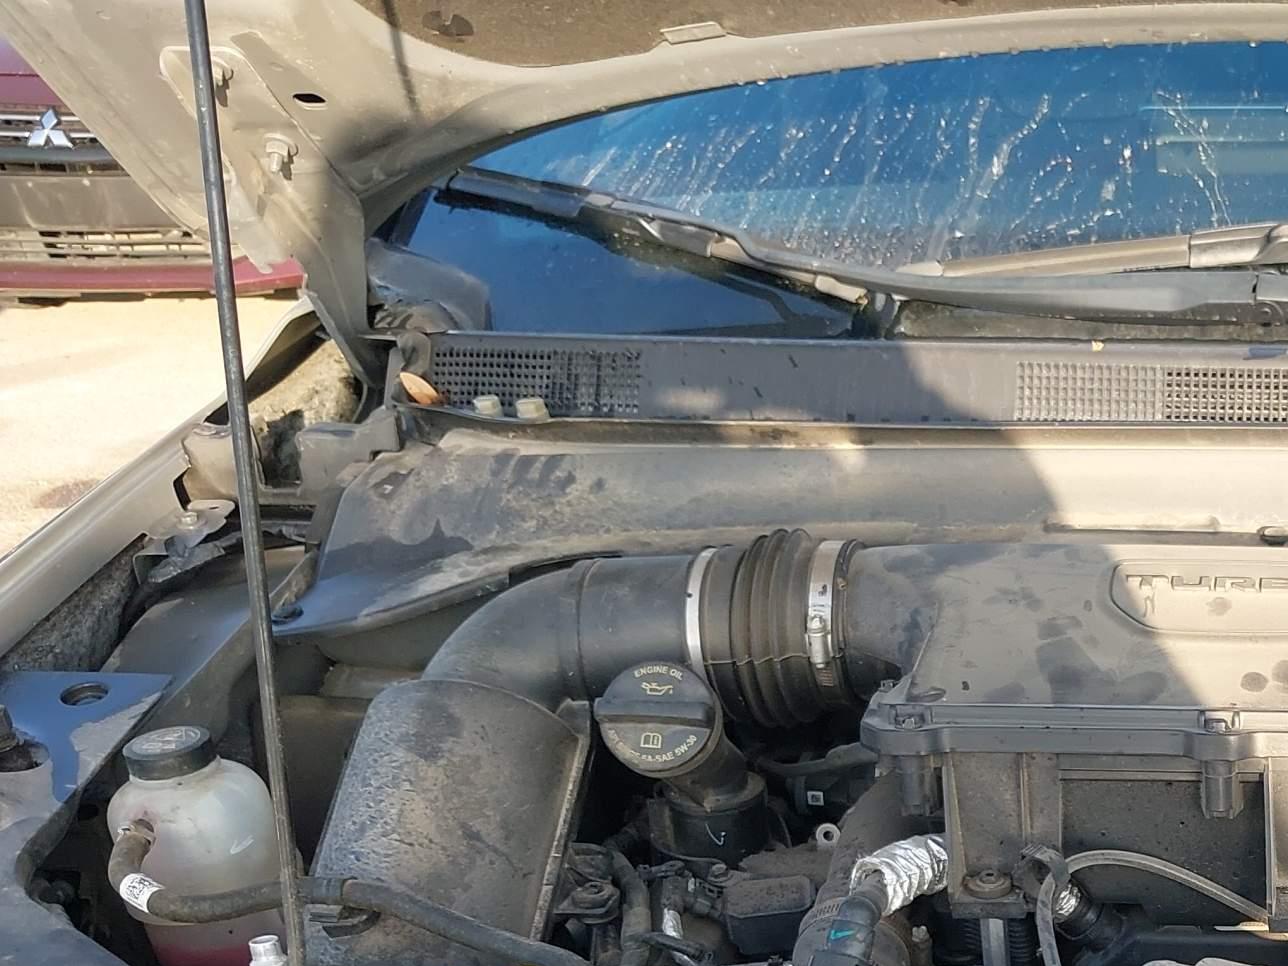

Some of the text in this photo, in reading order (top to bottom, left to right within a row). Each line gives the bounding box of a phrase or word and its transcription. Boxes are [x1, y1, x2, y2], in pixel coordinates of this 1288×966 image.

[634, 665, 683, 680] ENGINE OIL
[674, 734, 697, 757] 5W-30
